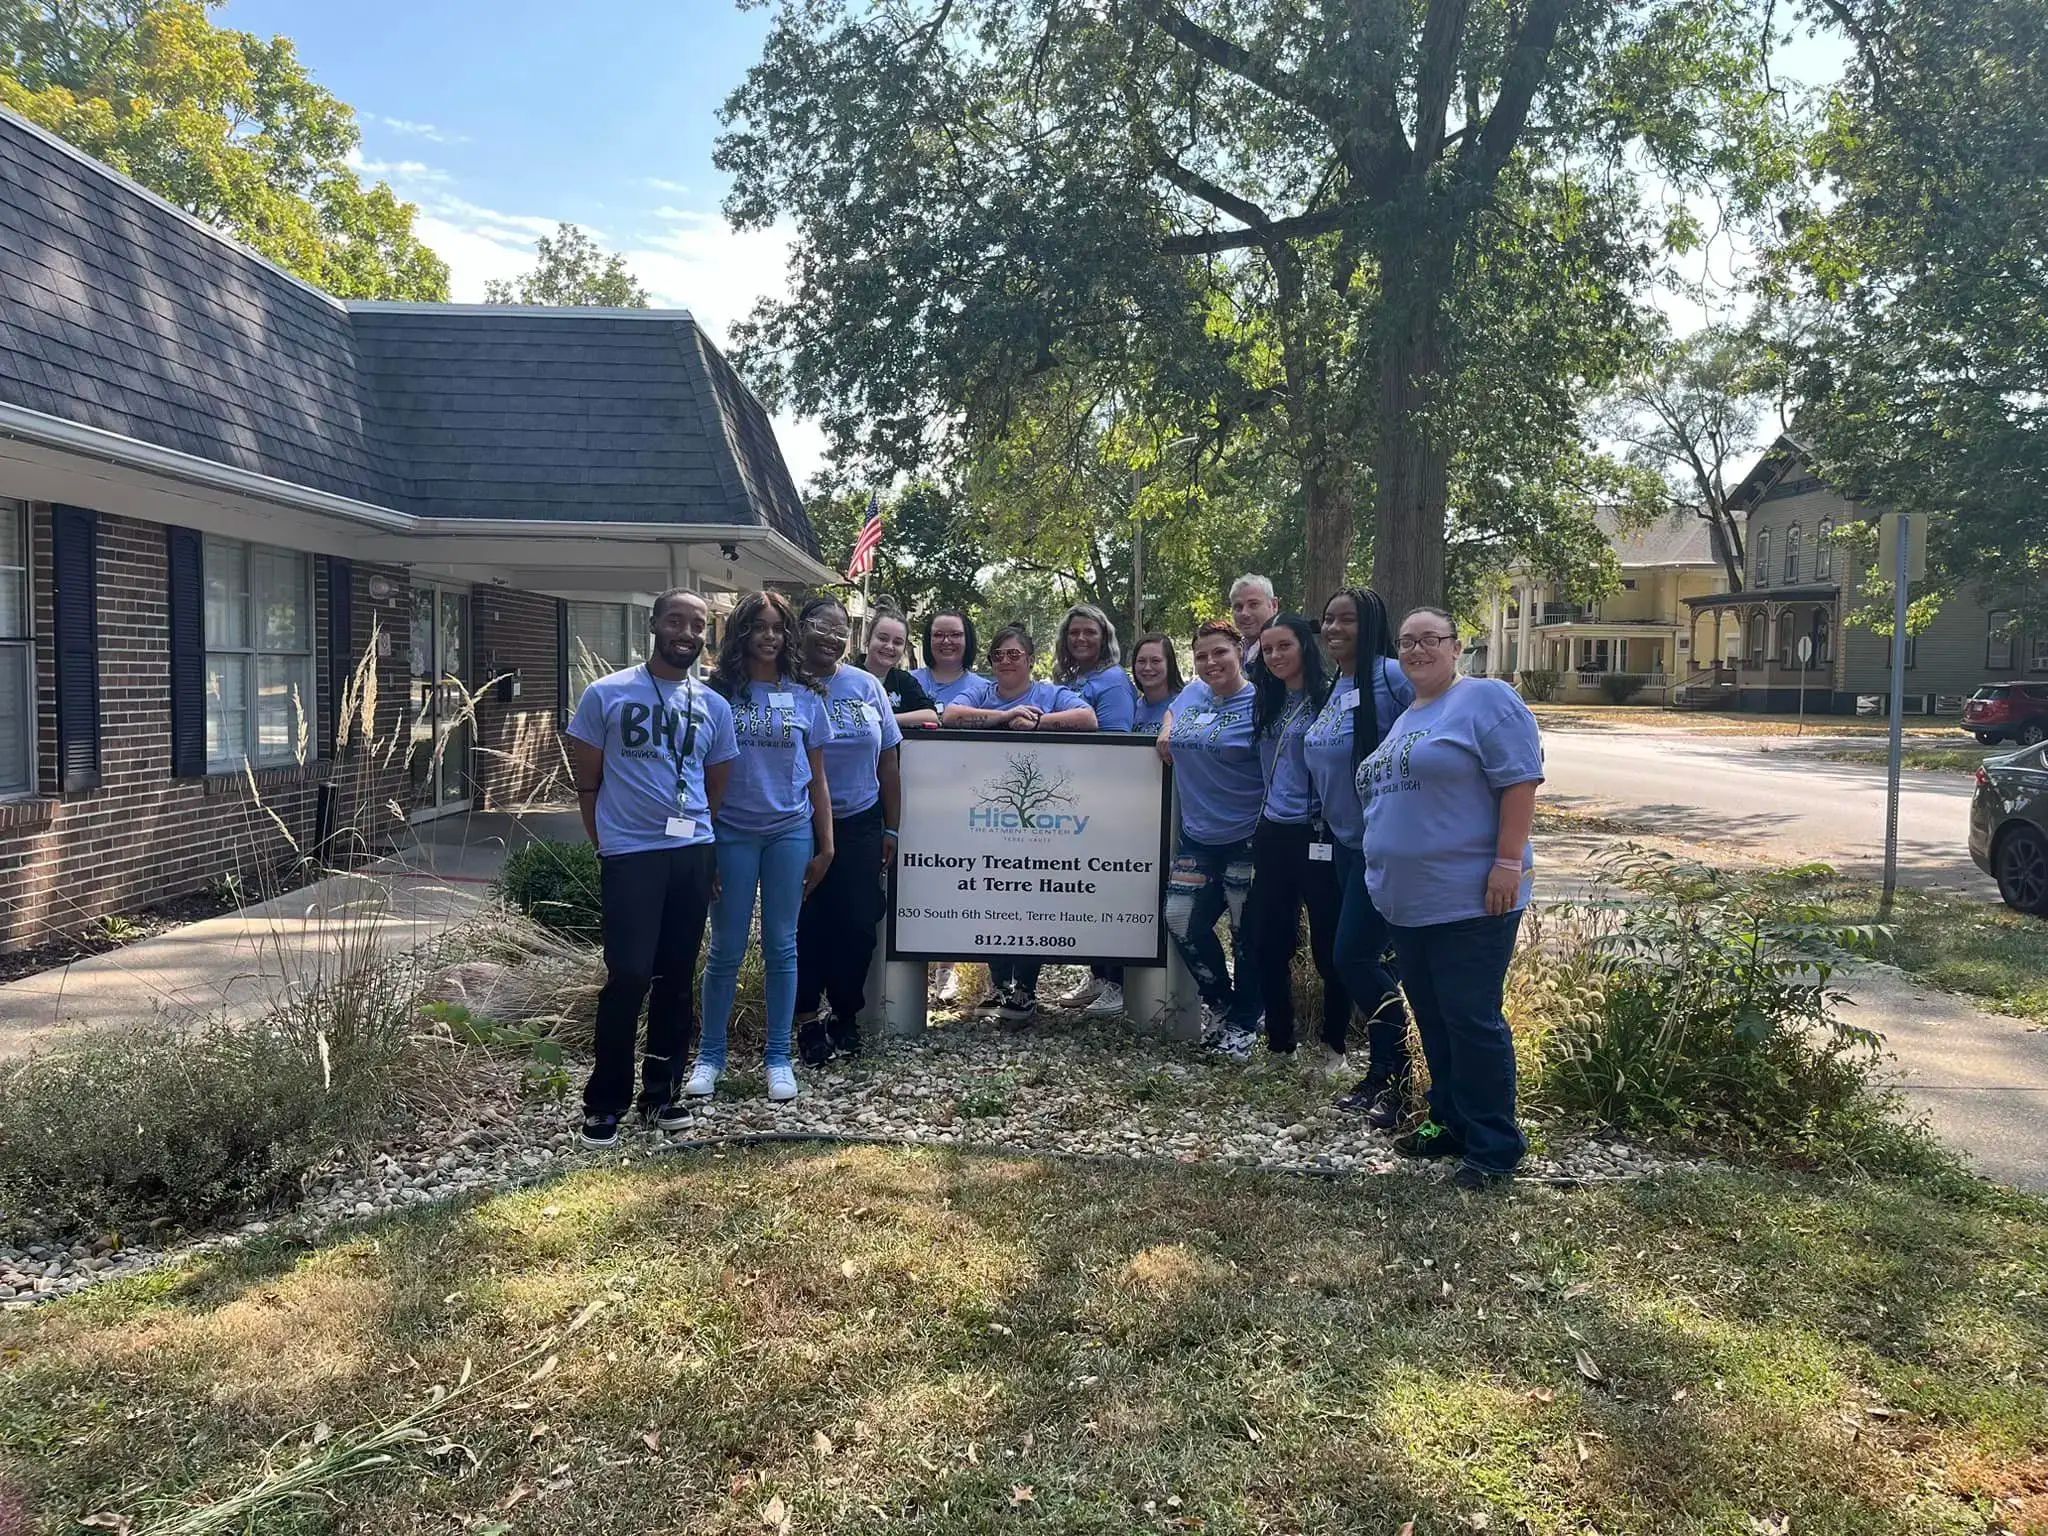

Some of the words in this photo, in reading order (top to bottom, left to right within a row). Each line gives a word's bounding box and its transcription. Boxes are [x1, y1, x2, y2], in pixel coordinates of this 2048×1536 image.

[620, 702, 705, 757] BHT
[969, 807, 1090, 835] Hickory
[903, 853, 976, 872] Hickory
[982, 855, 1081, 872] Treatment
[1088, 857, 1153, 873] Center
[957, 877, 977, 891] at
[983, 878, 1033, 892] Terre
[1039, 879, 1096, 894] Haute
[898, 908, 921, 918] 830
[924, 908, 958, 919] South
[961, 909, 981, 919] 6th
[984, 909, 1022, 922] Street,
[1026, 911, 1056, 921] Terre
[1059, 912, 1097, 923] Haute,
[1101, 912, 1113, 922] IN
[1116, 913, 1154, 924] 47807
[974, 934, 1077, 948] 812.213.8080
